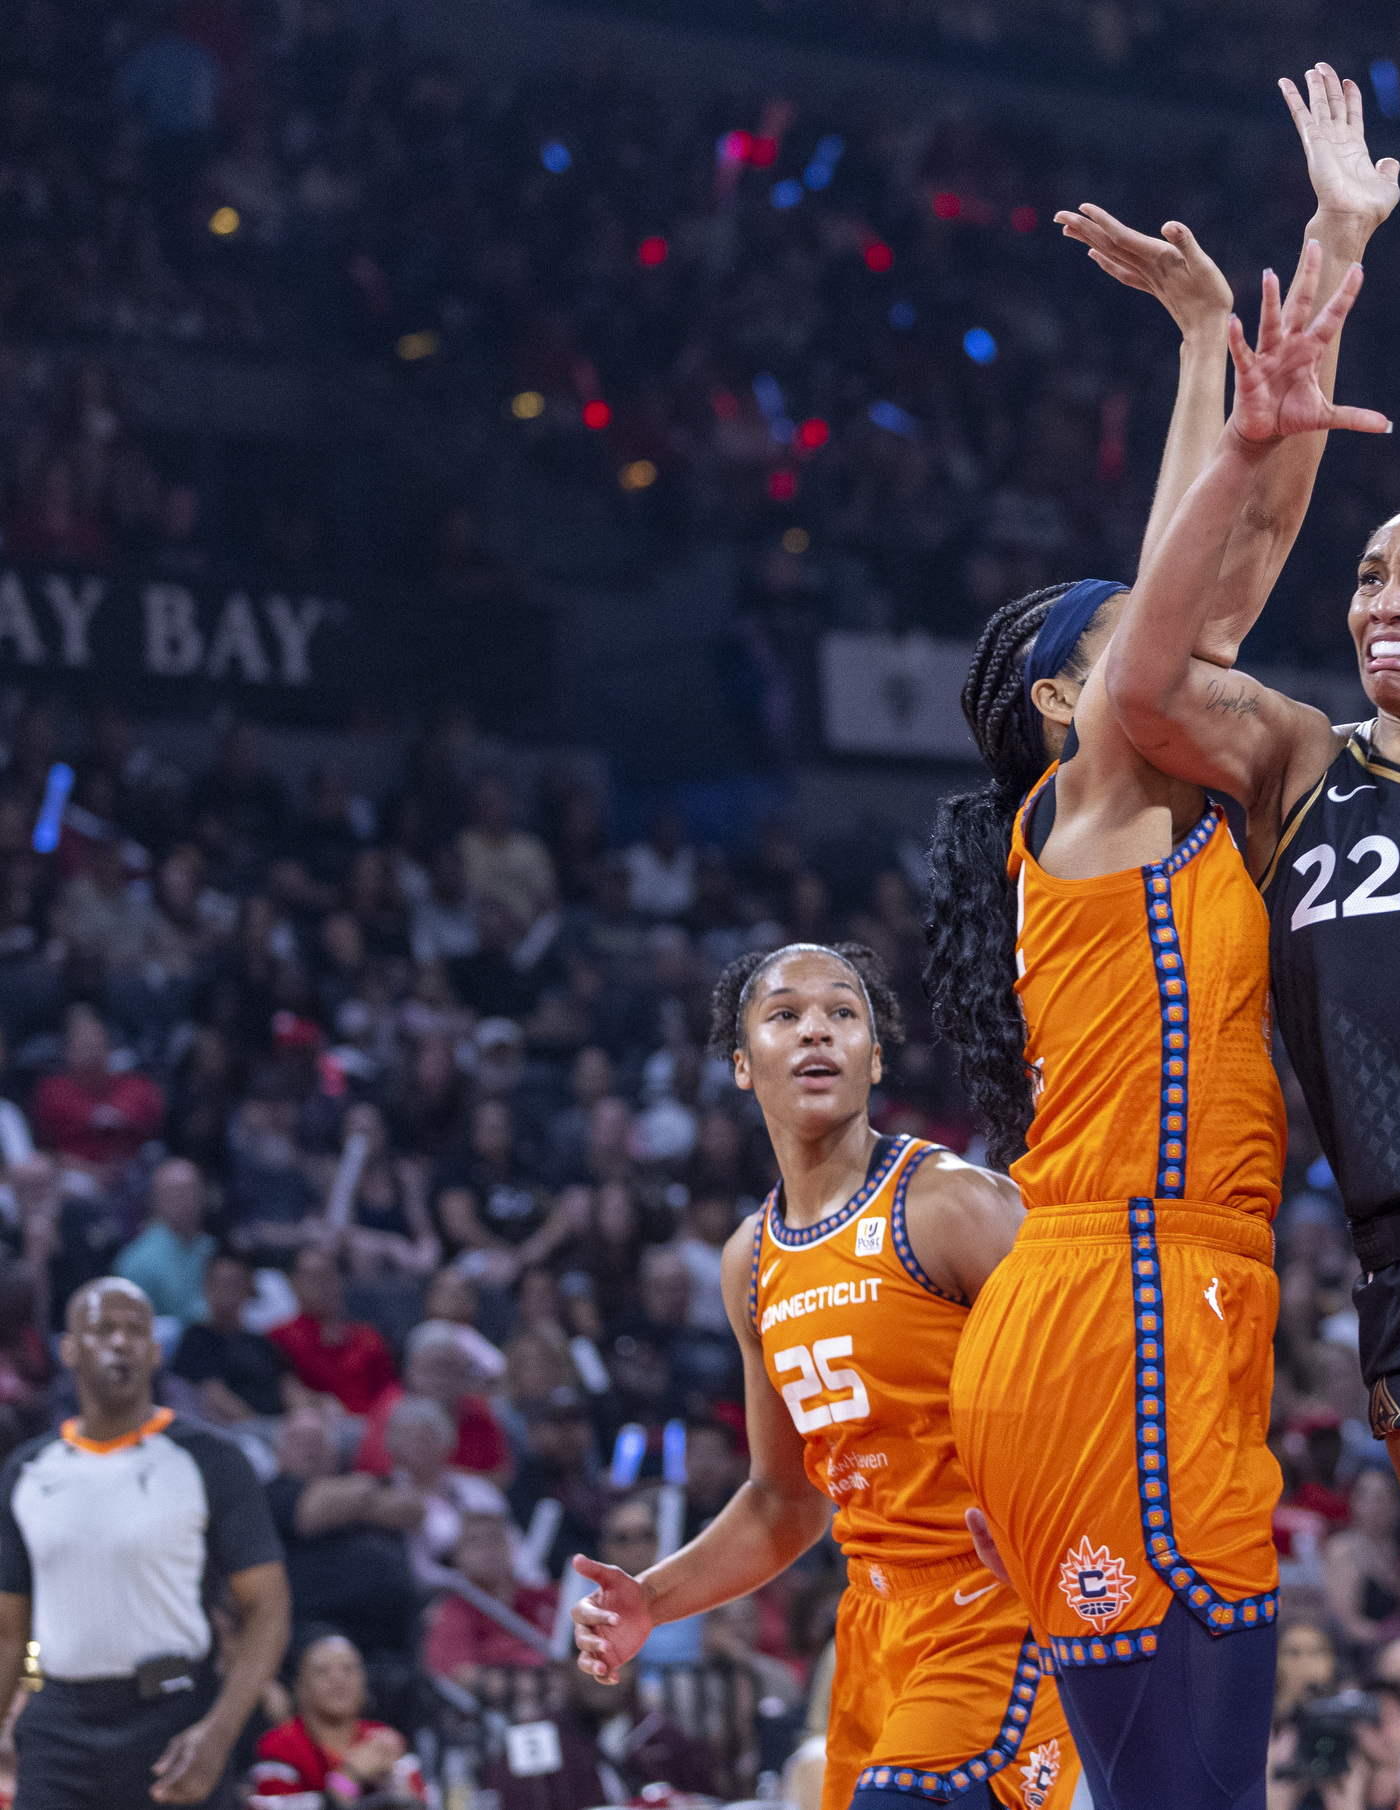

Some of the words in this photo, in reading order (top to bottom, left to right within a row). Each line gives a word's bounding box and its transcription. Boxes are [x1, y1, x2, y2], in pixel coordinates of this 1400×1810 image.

[143, 583, 330, 686] BAY
[774, 1335, 870, 1434] 25
[1078, 1570, 1107, 1598] C
